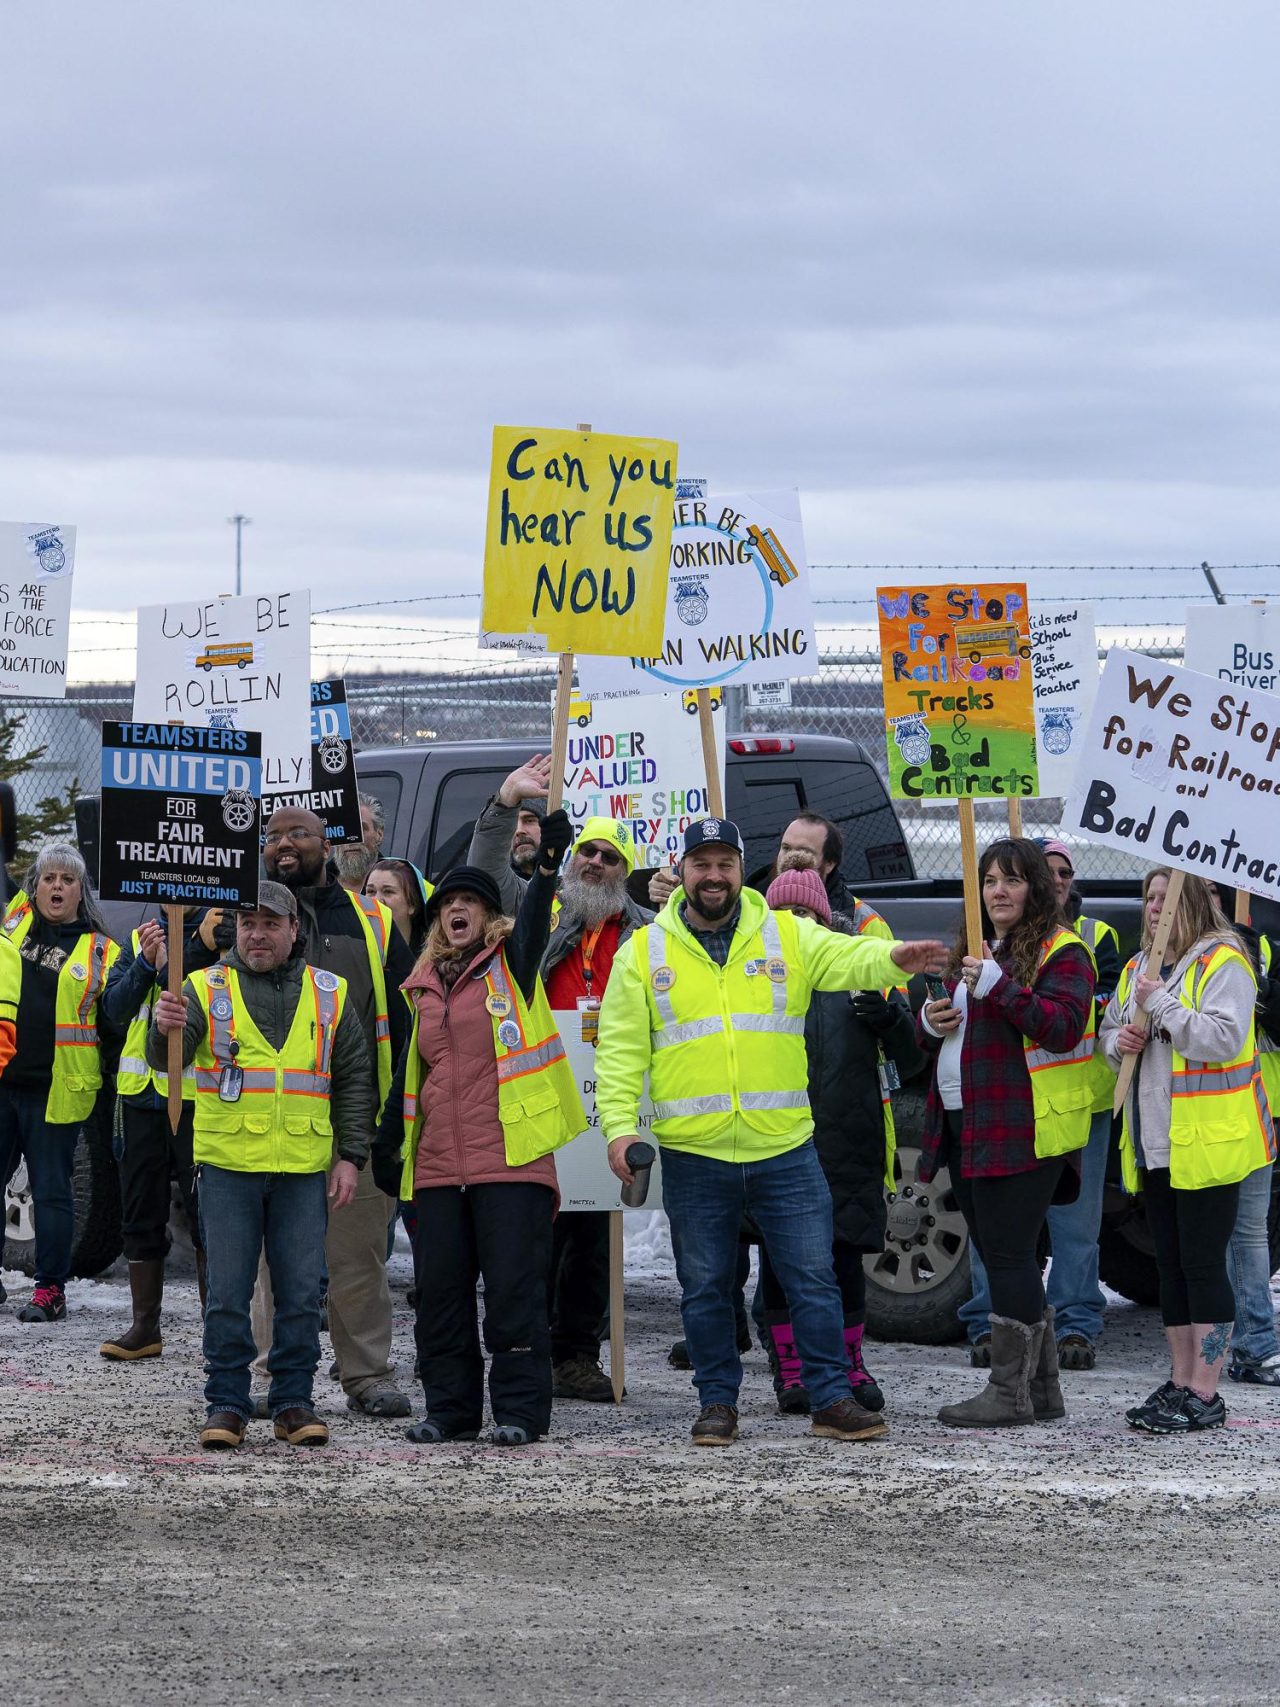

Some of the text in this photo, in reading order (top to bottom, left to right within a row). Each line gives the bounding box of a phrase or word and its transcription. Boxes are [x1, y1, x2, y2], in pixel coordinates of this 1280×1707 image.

[507, 438, 673, 506] Can you
[27, 526, 60, 542] TEAMSTERS
[500, 488, 586, 546] hear
[604, 511, 653, 551] us
[716, 507, 747, 538] BE
[670, 539, 753, 568] ORKING
[18, 584, 47, 597] ARE
[532, 559, 635, 618] NOW
[22, 597, 47, 611] THE
[161, 593, 291, 639] WE BE
[4, 611, 56, 637] FORCE
[908, 623, 950, 654] For
[698, 629, 808, 661] WALKING
[1233, 643, 1274, 670] Bus
[165, 673, 281, 712] ROLLIN
[1033, 679, 1080, 698] Teacher
[1127, 665, 1192, 717] We
[1219, 668, 1280, 690] Driver
[204, 707, 239, 715] TEAMSTERS
[907, 686, 994, 712] Tracks
[889, 711, 927, 725] TEAMSTERS
[951, 713, 971, 745] &
[118, 723, 248, 751] TEAMSTERS
[569, 731, 645, 765] UNDER
[1103, 715, 1153, 759] for
[930, 737, 990, 772] Bad
[113, 752, 251, 791] UNITED
[564, 758, 657, 789] VALUED
[901, 766, 1033, 797] Contracts
[262, 789, 344, 816] EATMENT
[610, 793, 643, 819] WE
[651, 788, 708, 816] SHO
[1176, 783, 1209, 799] and
[166, 800, 196, 816] FOR
[157, 821, 204, 844] FAIR
[1079, 780, 1280, 886] Bad Contrac
[116, 840, 245, 869] TREATMENT
[119, 880, 154, 895] JUST
[157, 882, 239, 901] PRACTICING
[140, 871, 220, 884] TEAMSTERS LOCAL 959
